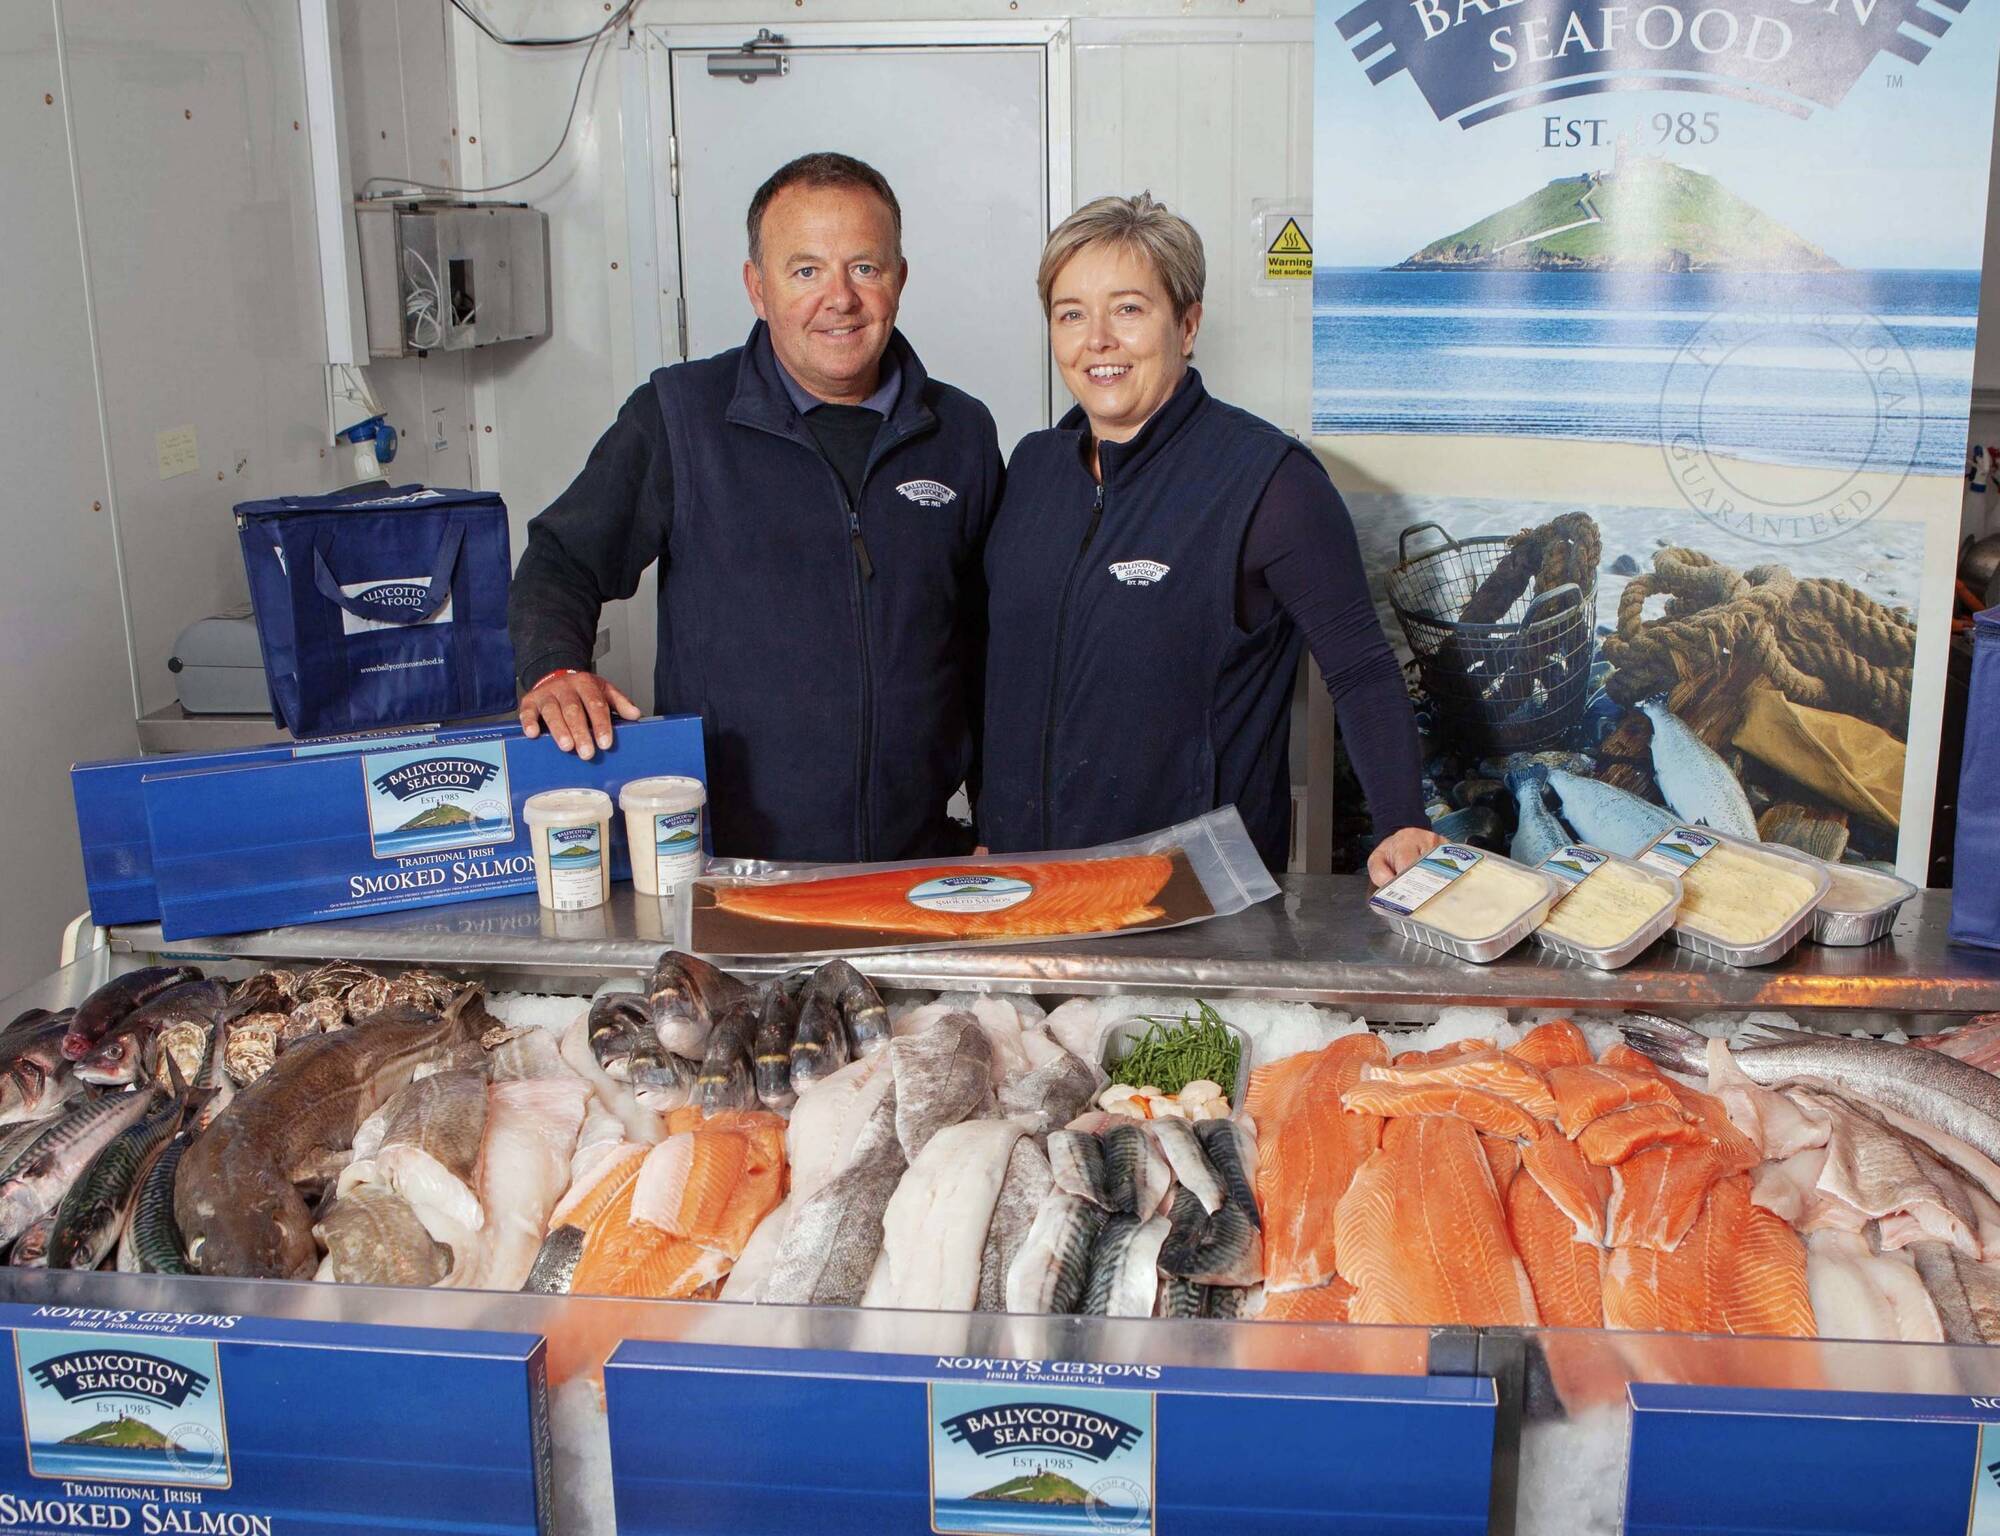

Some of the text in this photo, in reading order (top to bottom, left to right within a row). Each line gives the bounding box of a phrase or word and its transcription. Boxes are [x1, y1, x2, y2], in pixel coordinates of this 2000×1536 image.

[1489, 5, 1793, 72] SEAFOOD
[1543, 115, 1612, 148] EST.
[1268, 257, 1313, 269] Warning
[1671, 432, 1873, 540] GUARANTEED
[362, 586, 427, 602] ALLYCOTTO
[388, 761, 486, 786] BALLYCOTTON
[406, 774, 470, 791] SEAFOOD
[440, 793, 460, 802] 1985
[397, 847, 495, 869] TRADITIONAL IRISH
[350, 867, 446, 898] SMOKED
[32, 1306, 243, 1328] SMOKED SALMON
[69, 1319, 178, 1333] TRADITIONAL IRISH
[51, 1355, 189, 1387] BALLYCOTTON
[936, 1356, 1162, 1380] SMOKED SALMON
[986, 1370, 1104, 1385] TRADITIONAL IRISH
[76, 1374, 168, 1396] SEAFOOD
[124, 1404, 152, 1416] 1985
[965, 1408, 1120, 1441] BALLYCOTTON
[994, 1429, 1094, 1449] SEAFOOD
[1044, 1458, 1074, 1470] 1985
[62, 1481, 202, 1504] TRADITIONAL IRISH
[0, 1494, 272, 1536] SMOKED SALMON
